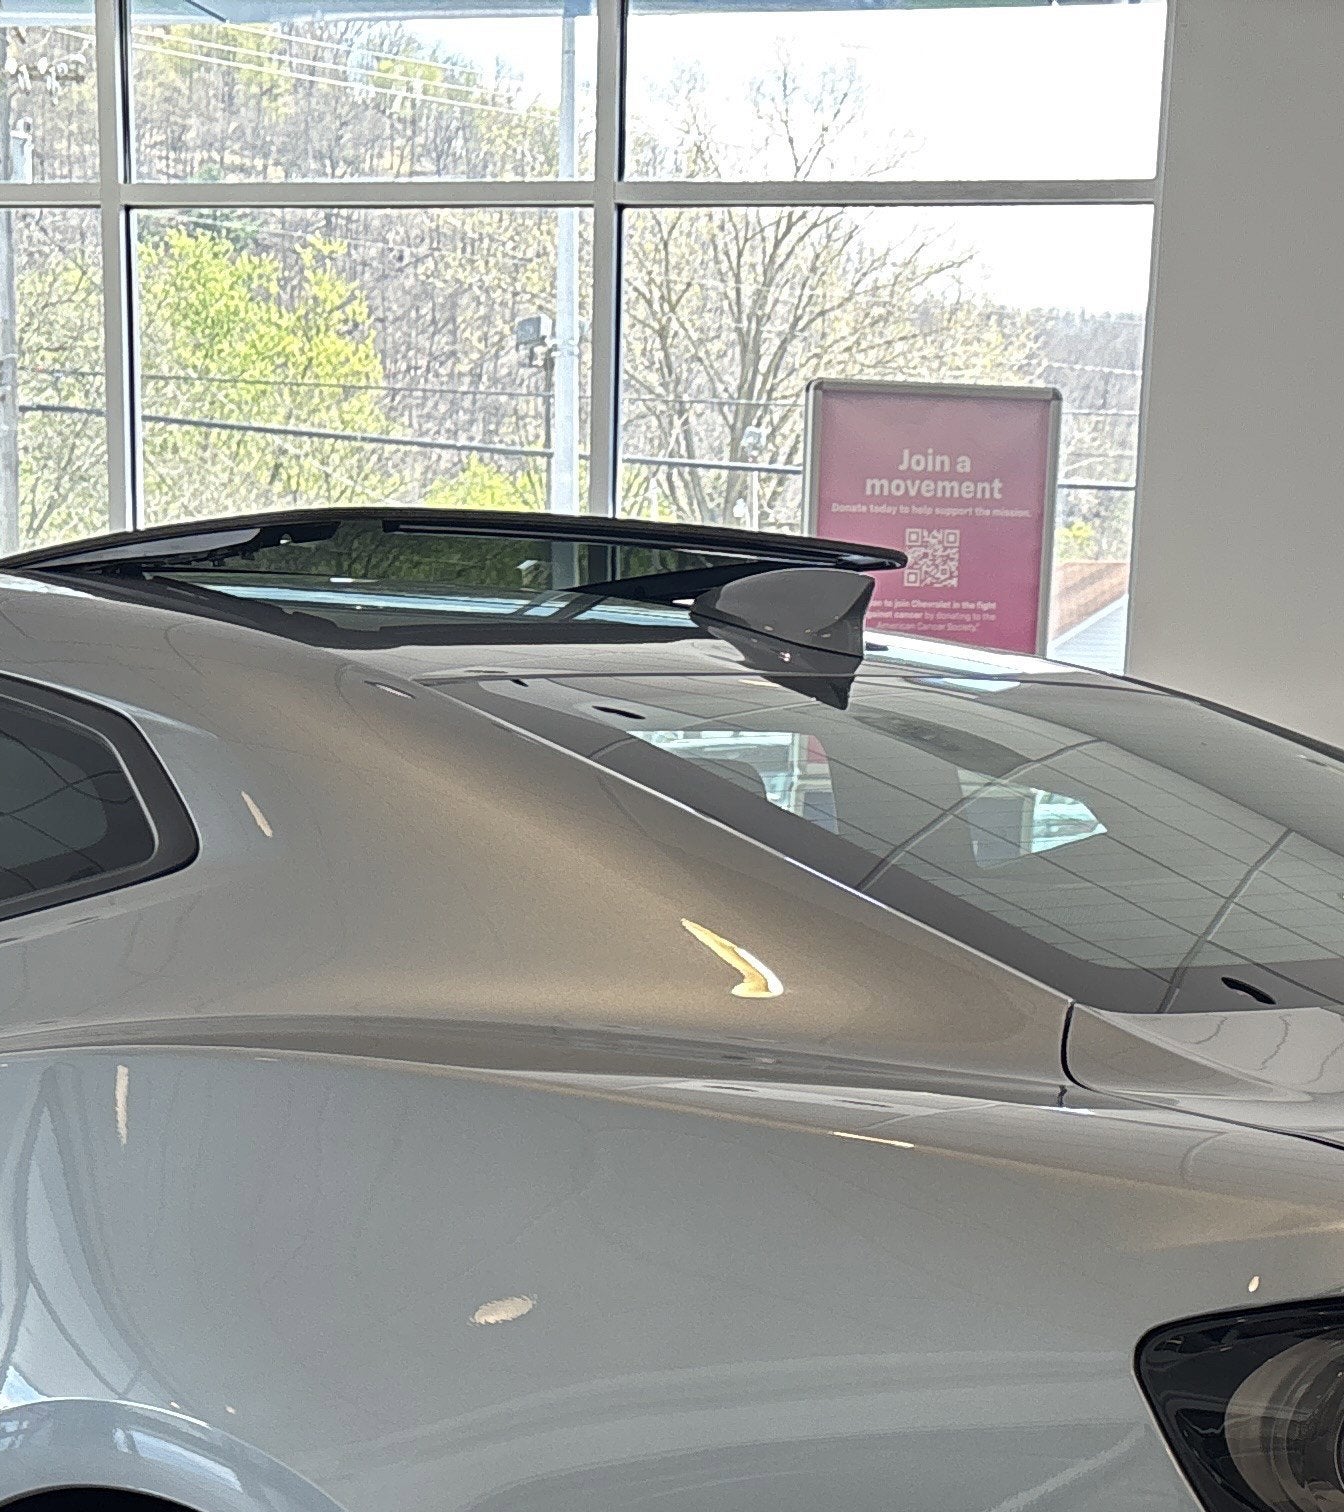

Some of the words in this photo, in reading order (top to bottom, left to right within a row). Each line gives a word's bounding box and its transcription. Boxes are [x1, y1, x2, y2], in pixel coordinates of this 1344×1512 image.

[897, 448, 950, 473] Join
[956, 455, 972, 473] a
[865, 477, 1003, 500] movement
[831, 503, 867, 513] Donate
[869, 504, 897, 515] today
[899, 504, 910, 514] to
[911, 505, 933, 516] help
[935, 506, 973, 517] support
[974, 506, 991, 517] the
[911, 599, 951, 609] Chevrolet
